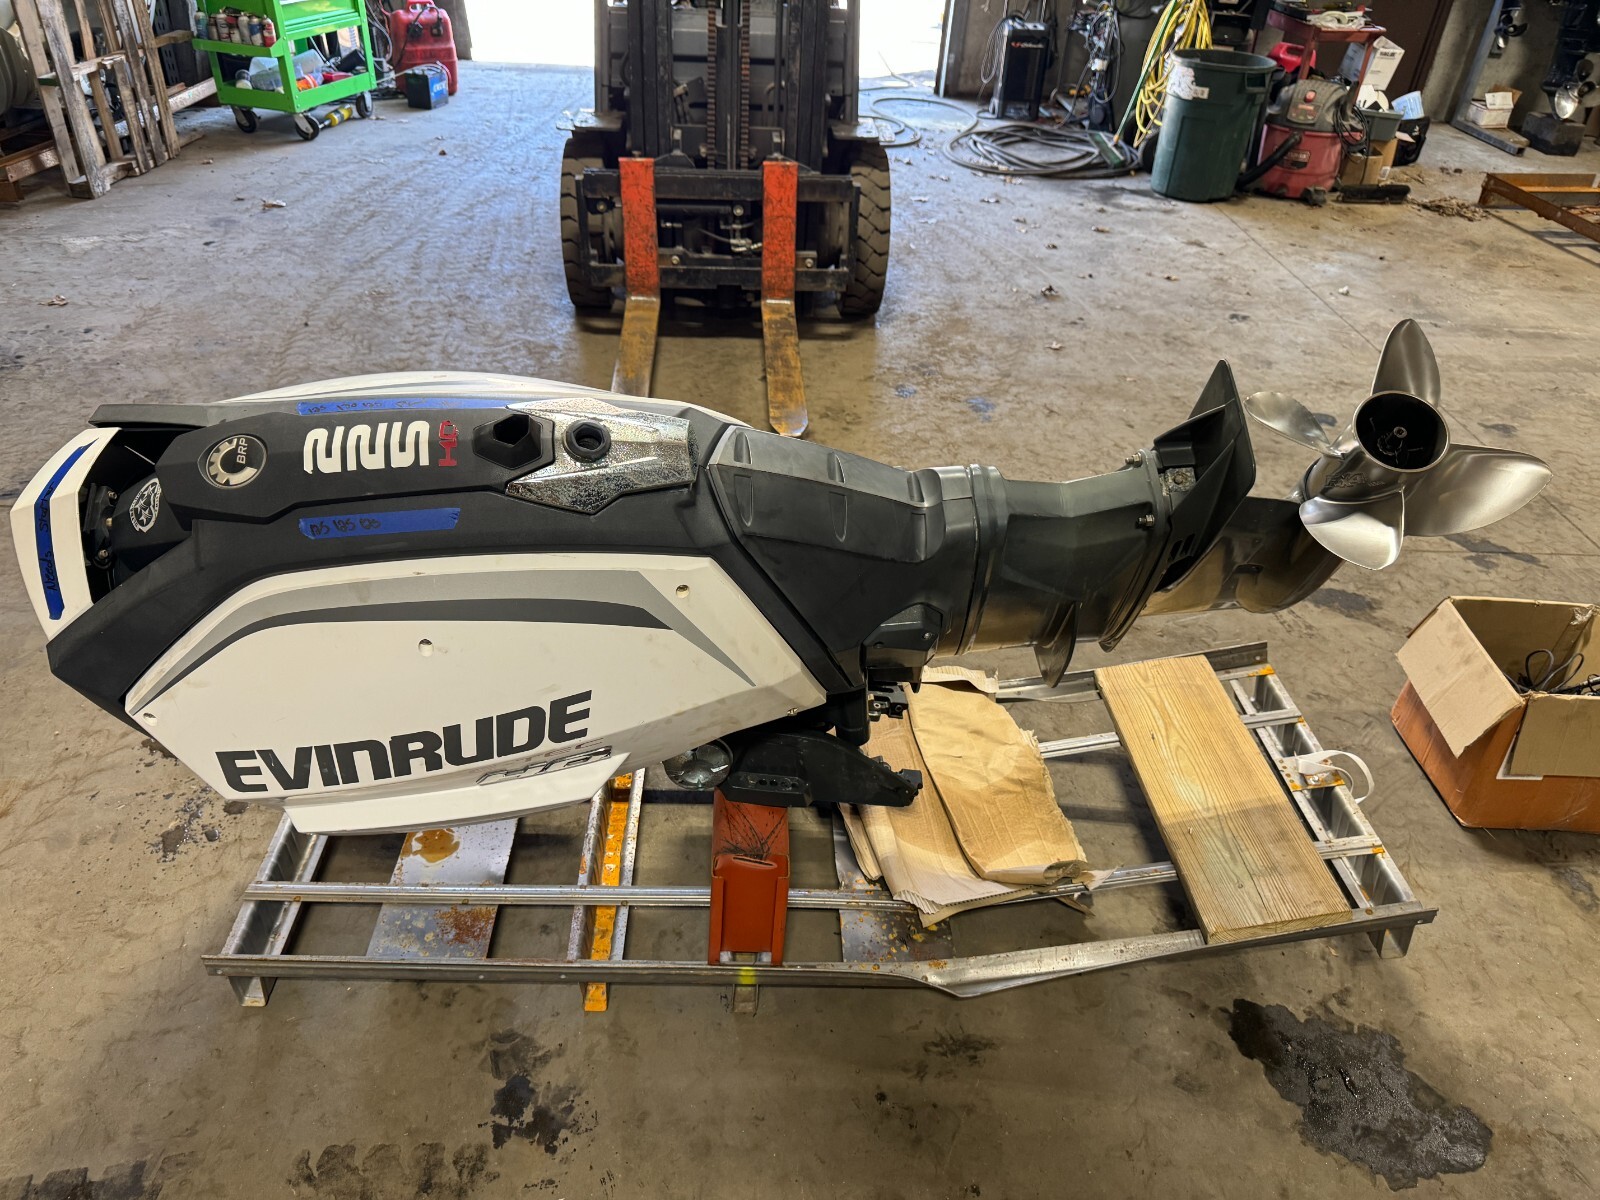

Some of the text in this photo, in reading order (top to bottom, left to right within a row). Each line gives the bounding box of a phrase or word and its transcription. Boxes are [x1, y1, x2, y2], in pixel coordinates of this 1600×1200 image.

[236, 437, 249, 465] BRP
[39, 481, 59, 591] Needs Starter
[215, 690, 592, 793] EVINRUDE
